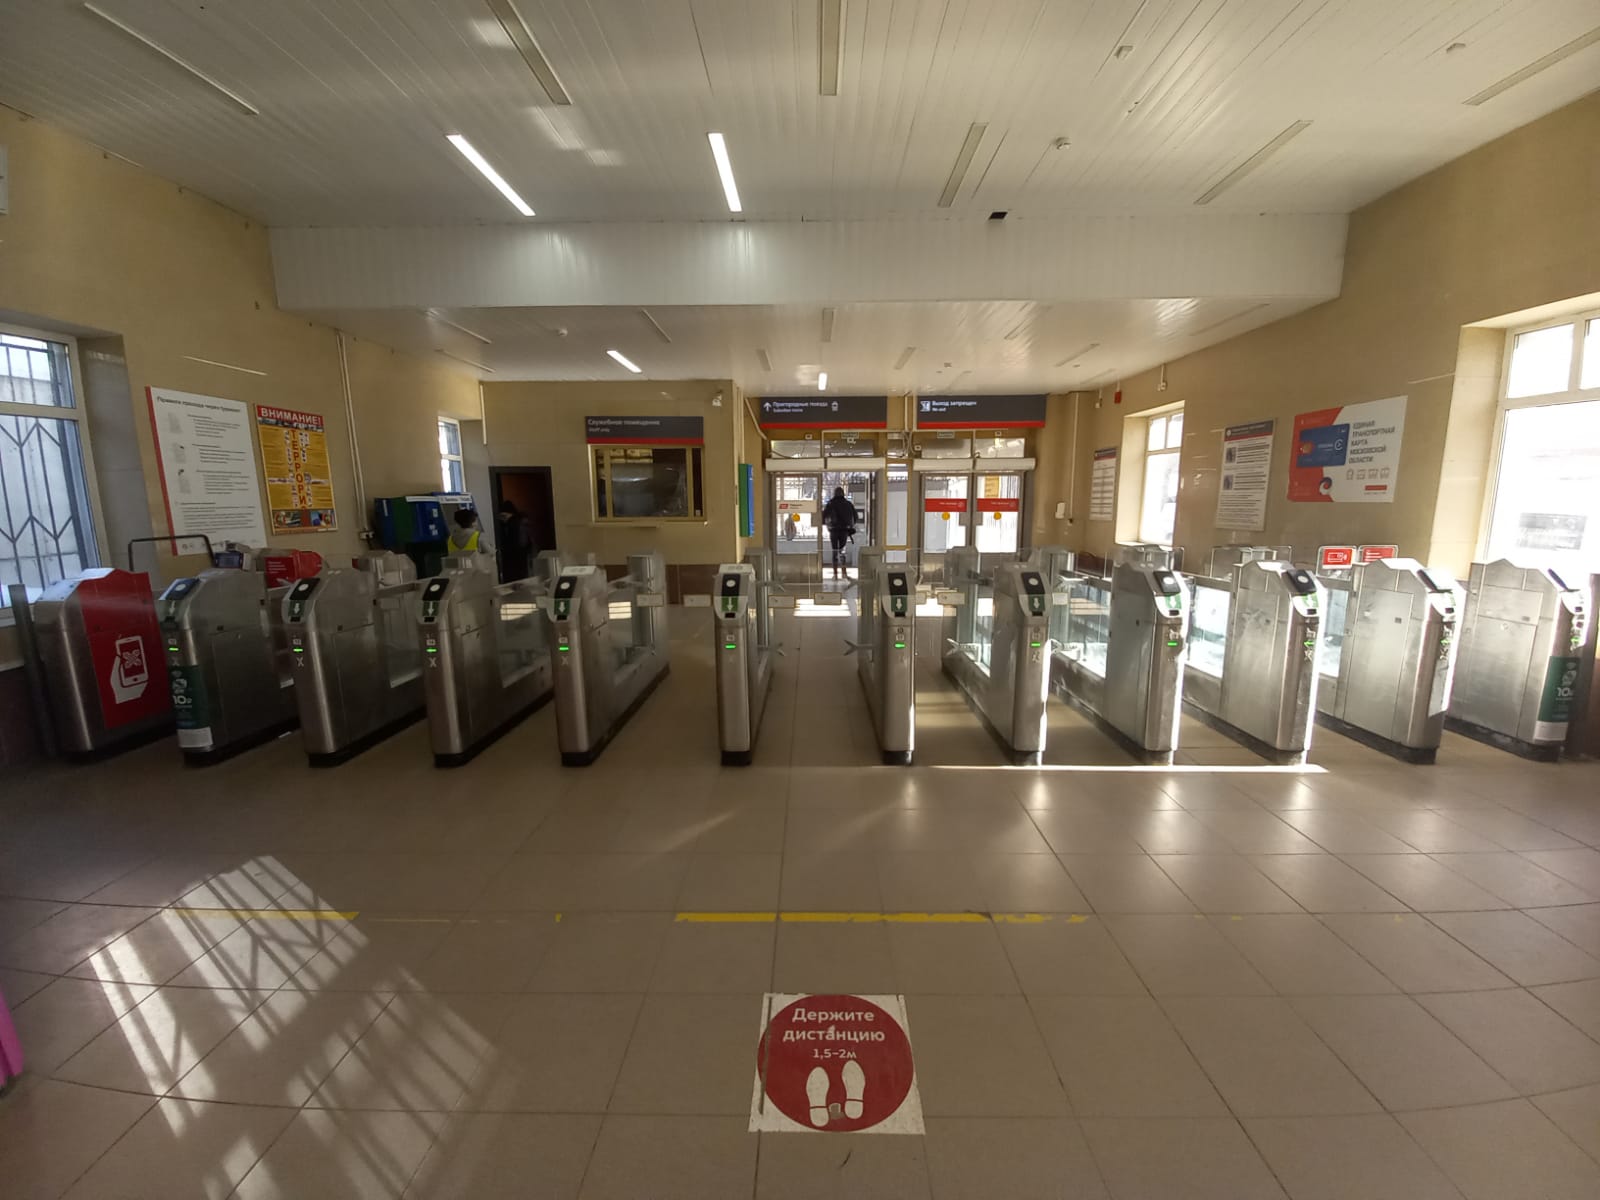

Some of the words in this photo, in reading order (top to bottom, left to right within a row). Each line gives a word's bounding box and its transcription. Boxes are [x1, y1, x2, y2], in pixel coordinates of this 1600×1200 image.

[261, 407, 321, 425] ВНИМАНИЕ!
[1351, 439, 1368, 447] КАРТА
[791, 1008, 875, 1023] Держите
[783, 1029, 886, 1043] дистанцию
